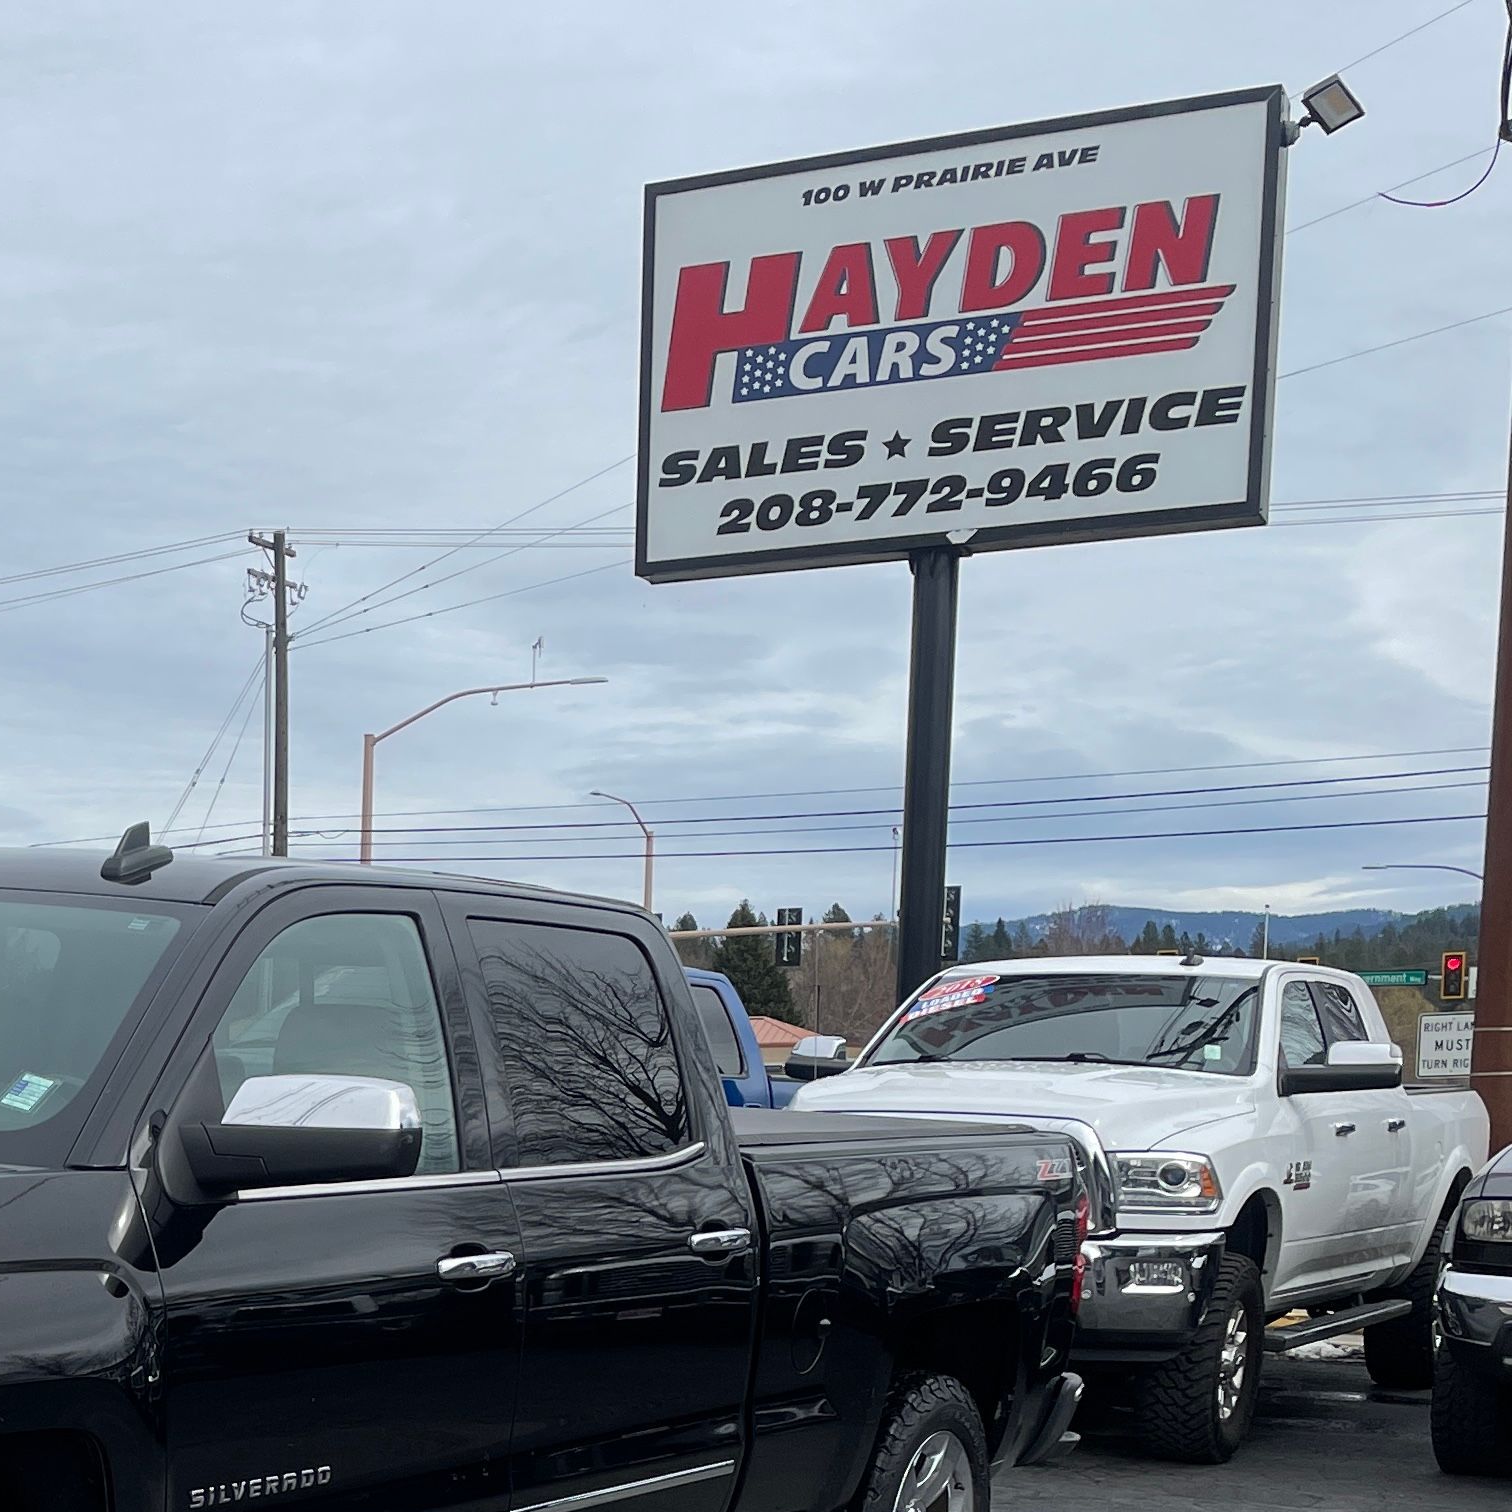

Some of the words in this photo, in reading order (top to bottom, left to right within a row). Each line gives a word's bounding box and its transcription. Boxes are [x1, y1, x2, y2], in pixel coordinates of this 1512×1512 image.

[801, 184, 850, 207] 100
[858, 178, 886, 198] W
[891, 156, 1027, 194] PRAIRIE
[1032, 145, 1101, 173] AVE
[660, 193, 1221, 413] HAYDEN
[788, 324, 961, 391] CARS
[658, 430, 868, 488] SALES
[928, 386, 1246, 457] SERVICE
[717, 453, 1161, 535] 208-772-9466
[908, 997, 979, 1021] DIESEL
[921, 988, 985, 1010] LOADED
[1423, 1022, 1453, 1032] RIGHT
[1434, 1038, 1471, 1051] MUST
[1422, 1059, 1448, 1070] TURN
[189, 1465, 332, 1509] SILVERADO
